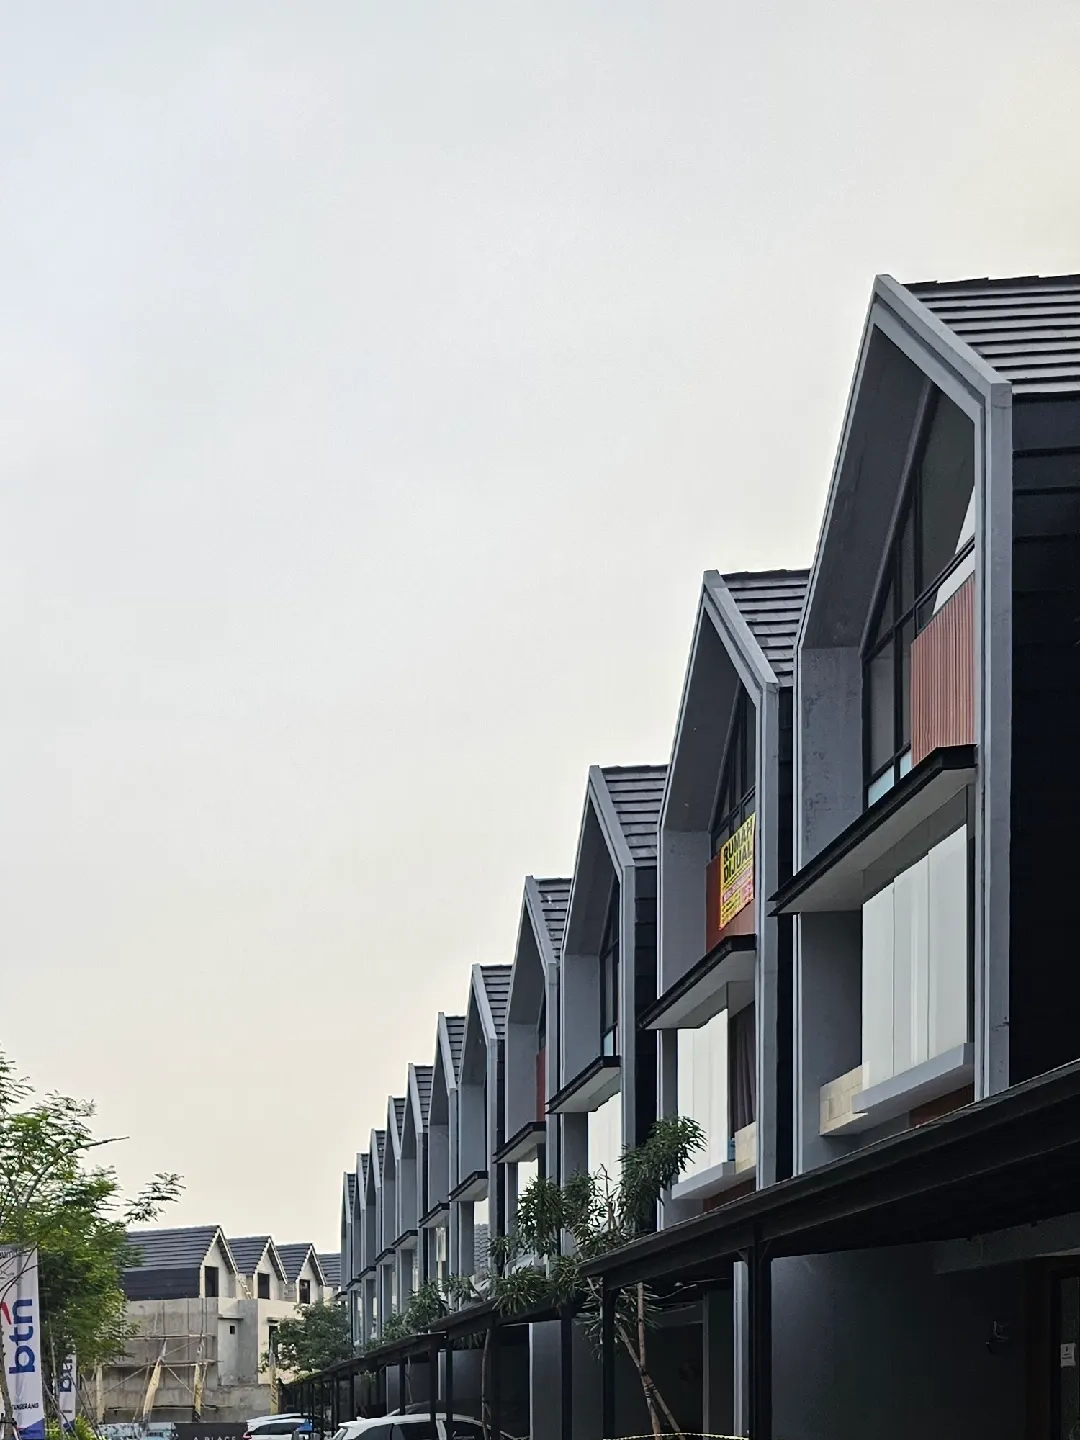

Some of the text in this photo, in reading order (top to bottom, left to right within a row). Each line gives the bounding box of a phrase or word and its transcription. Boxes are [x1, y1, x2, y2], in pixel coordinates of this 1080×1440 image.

[723, 818, 753, 865] RUMAH
[723, 839, 753, 883] DIJUAL
[9, 1299, 36, 1374] btn
